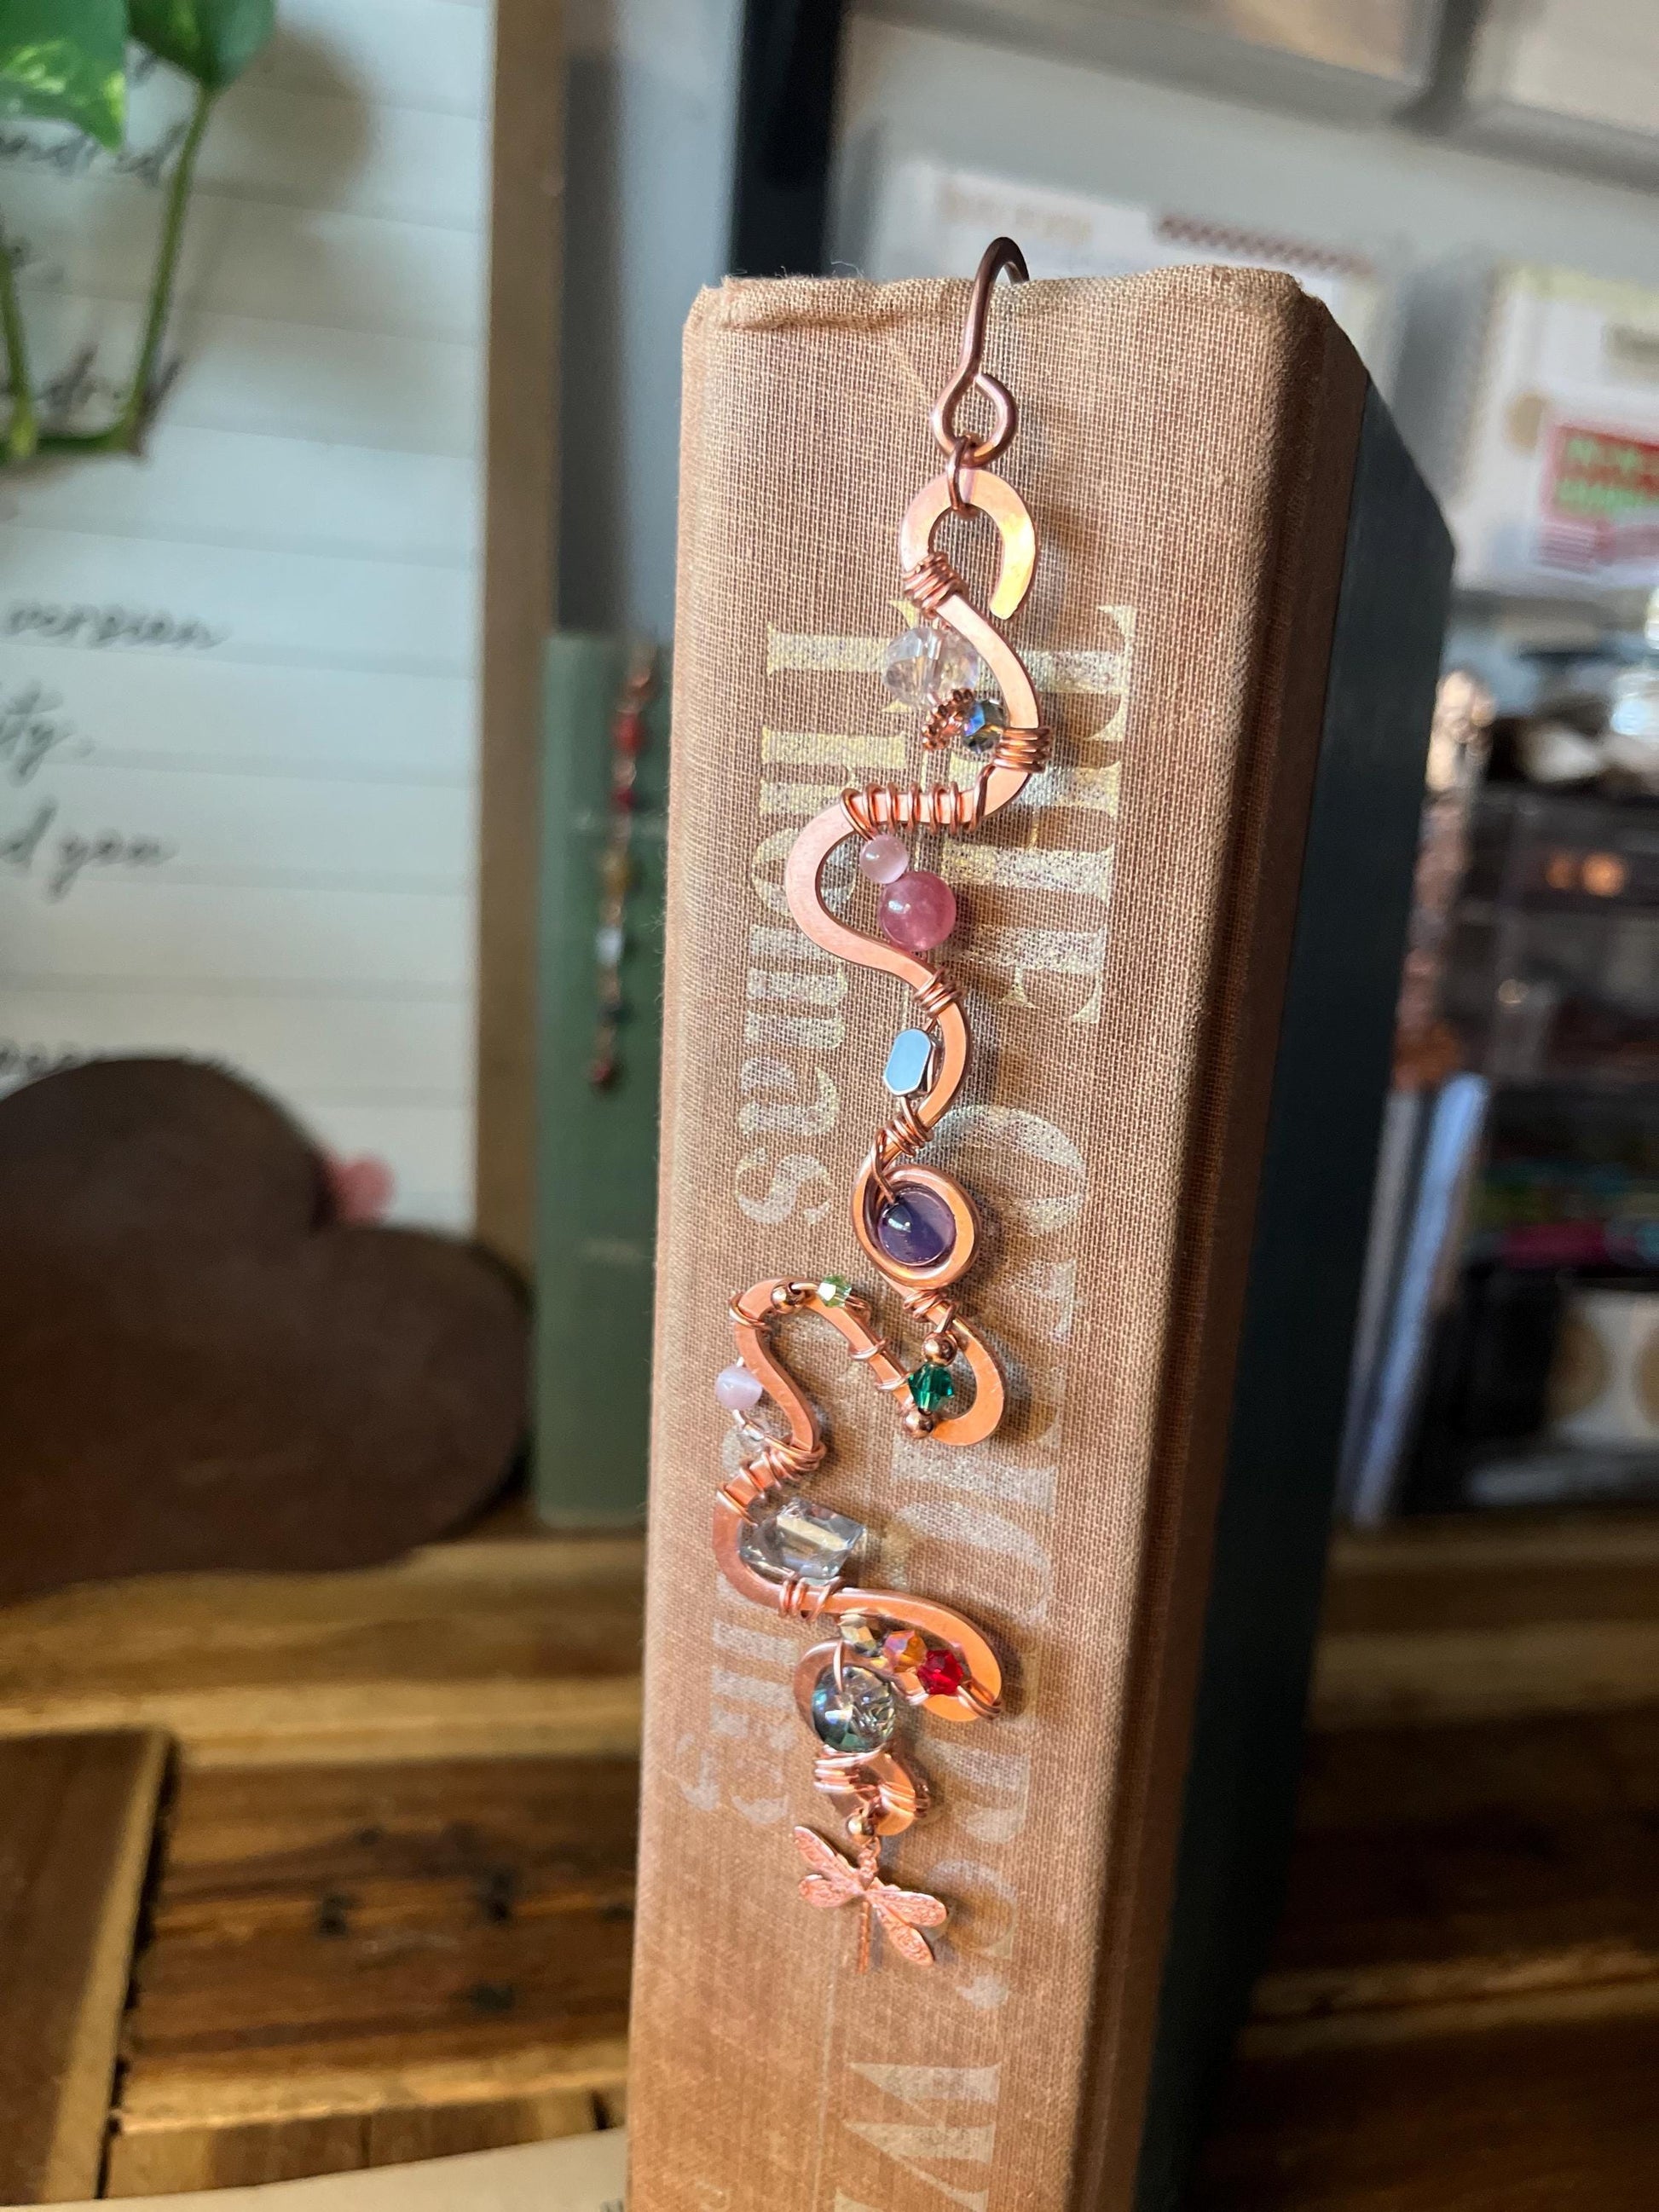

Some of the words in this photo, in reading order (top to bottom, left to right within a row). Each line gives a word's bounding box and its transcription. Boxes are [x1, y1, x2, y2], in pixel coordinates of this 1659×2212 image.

[734, 598, 919, 1226] Thomas
[934, 604, 1129, 1025] THE
[883, 1105, 1088, 2010] OFICRS'
[834, 2063, 1001, 2212] W
